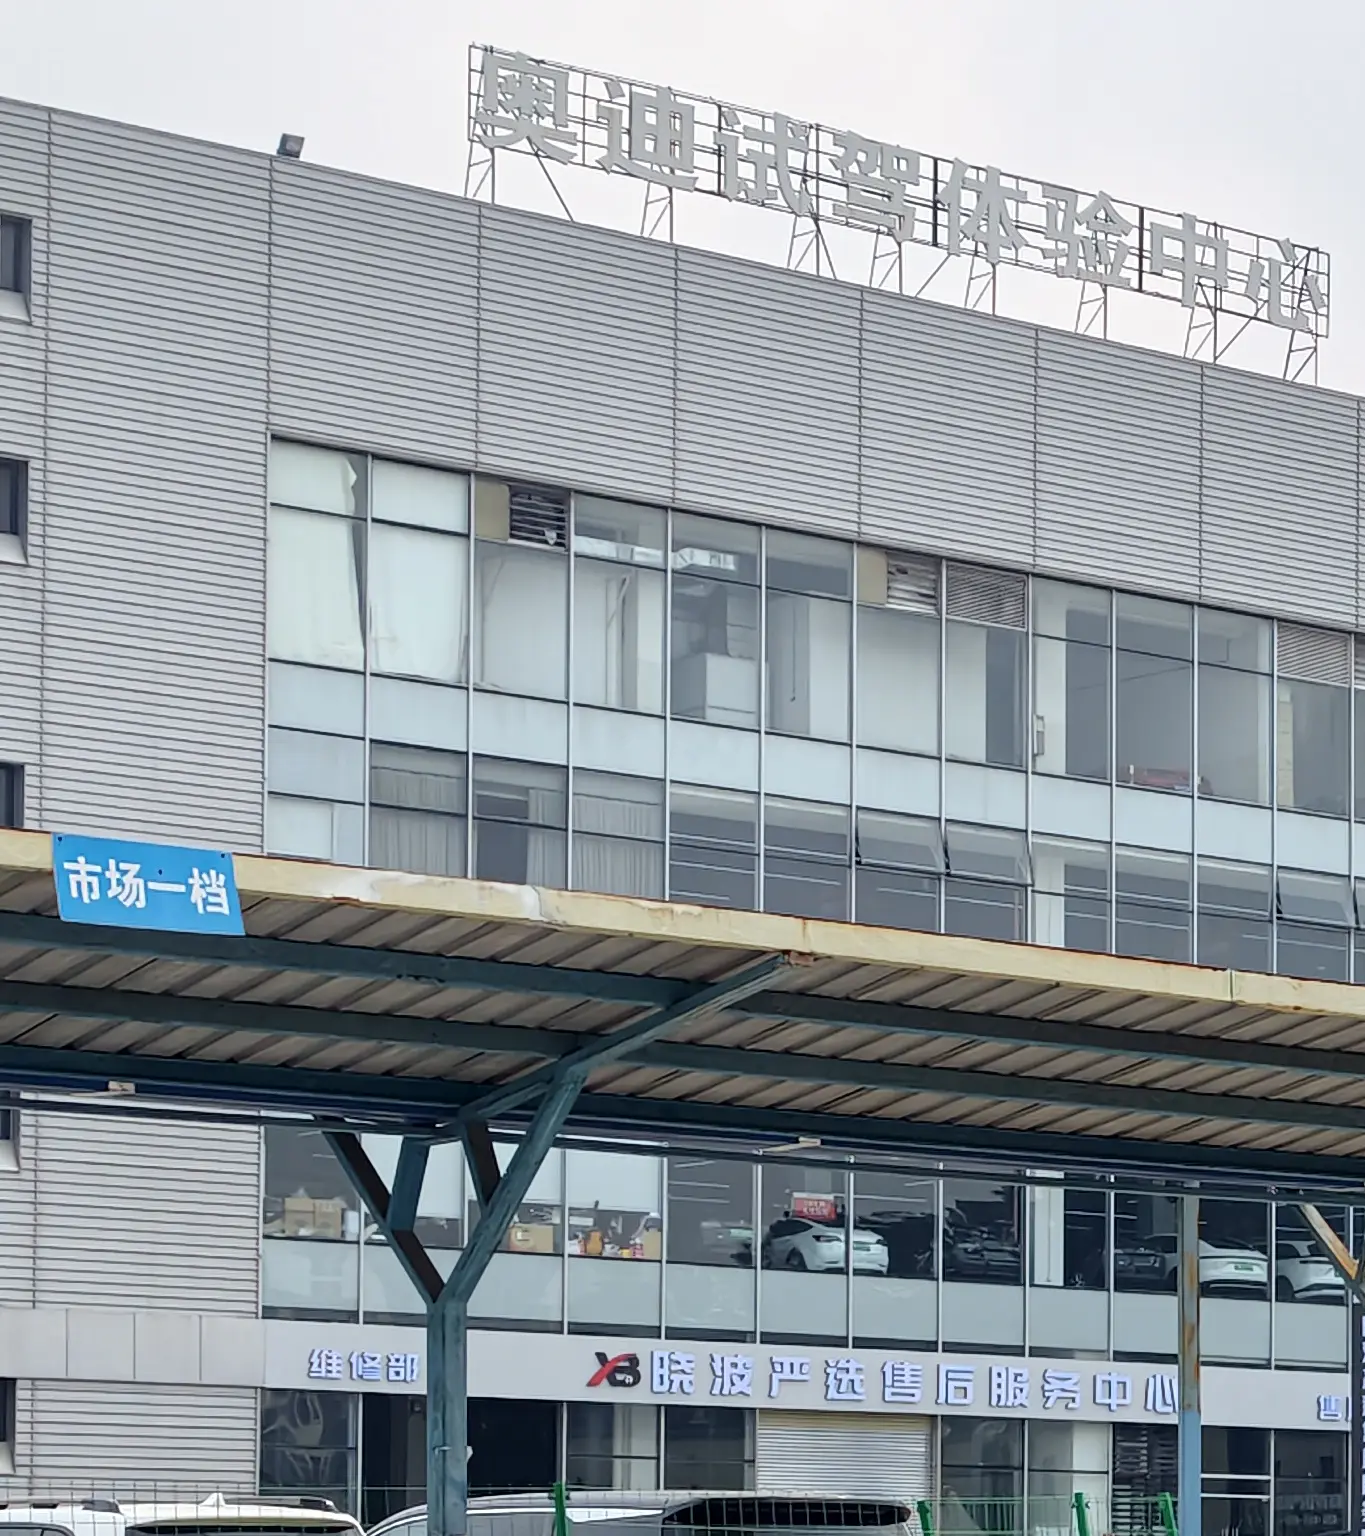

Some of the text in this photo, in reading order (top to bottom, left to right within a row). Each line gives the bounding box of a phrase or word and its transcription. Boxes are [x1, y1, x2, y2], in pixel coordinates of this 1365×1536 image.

[475, 51, 1327, 332] 奥迪试驾体验中心
[63, 856, 230, 917] 市场一档
[307, 1348, 420, 1383] 维修部
[649, 1349, 1179, 1415] 晓波严选售后服务中心
